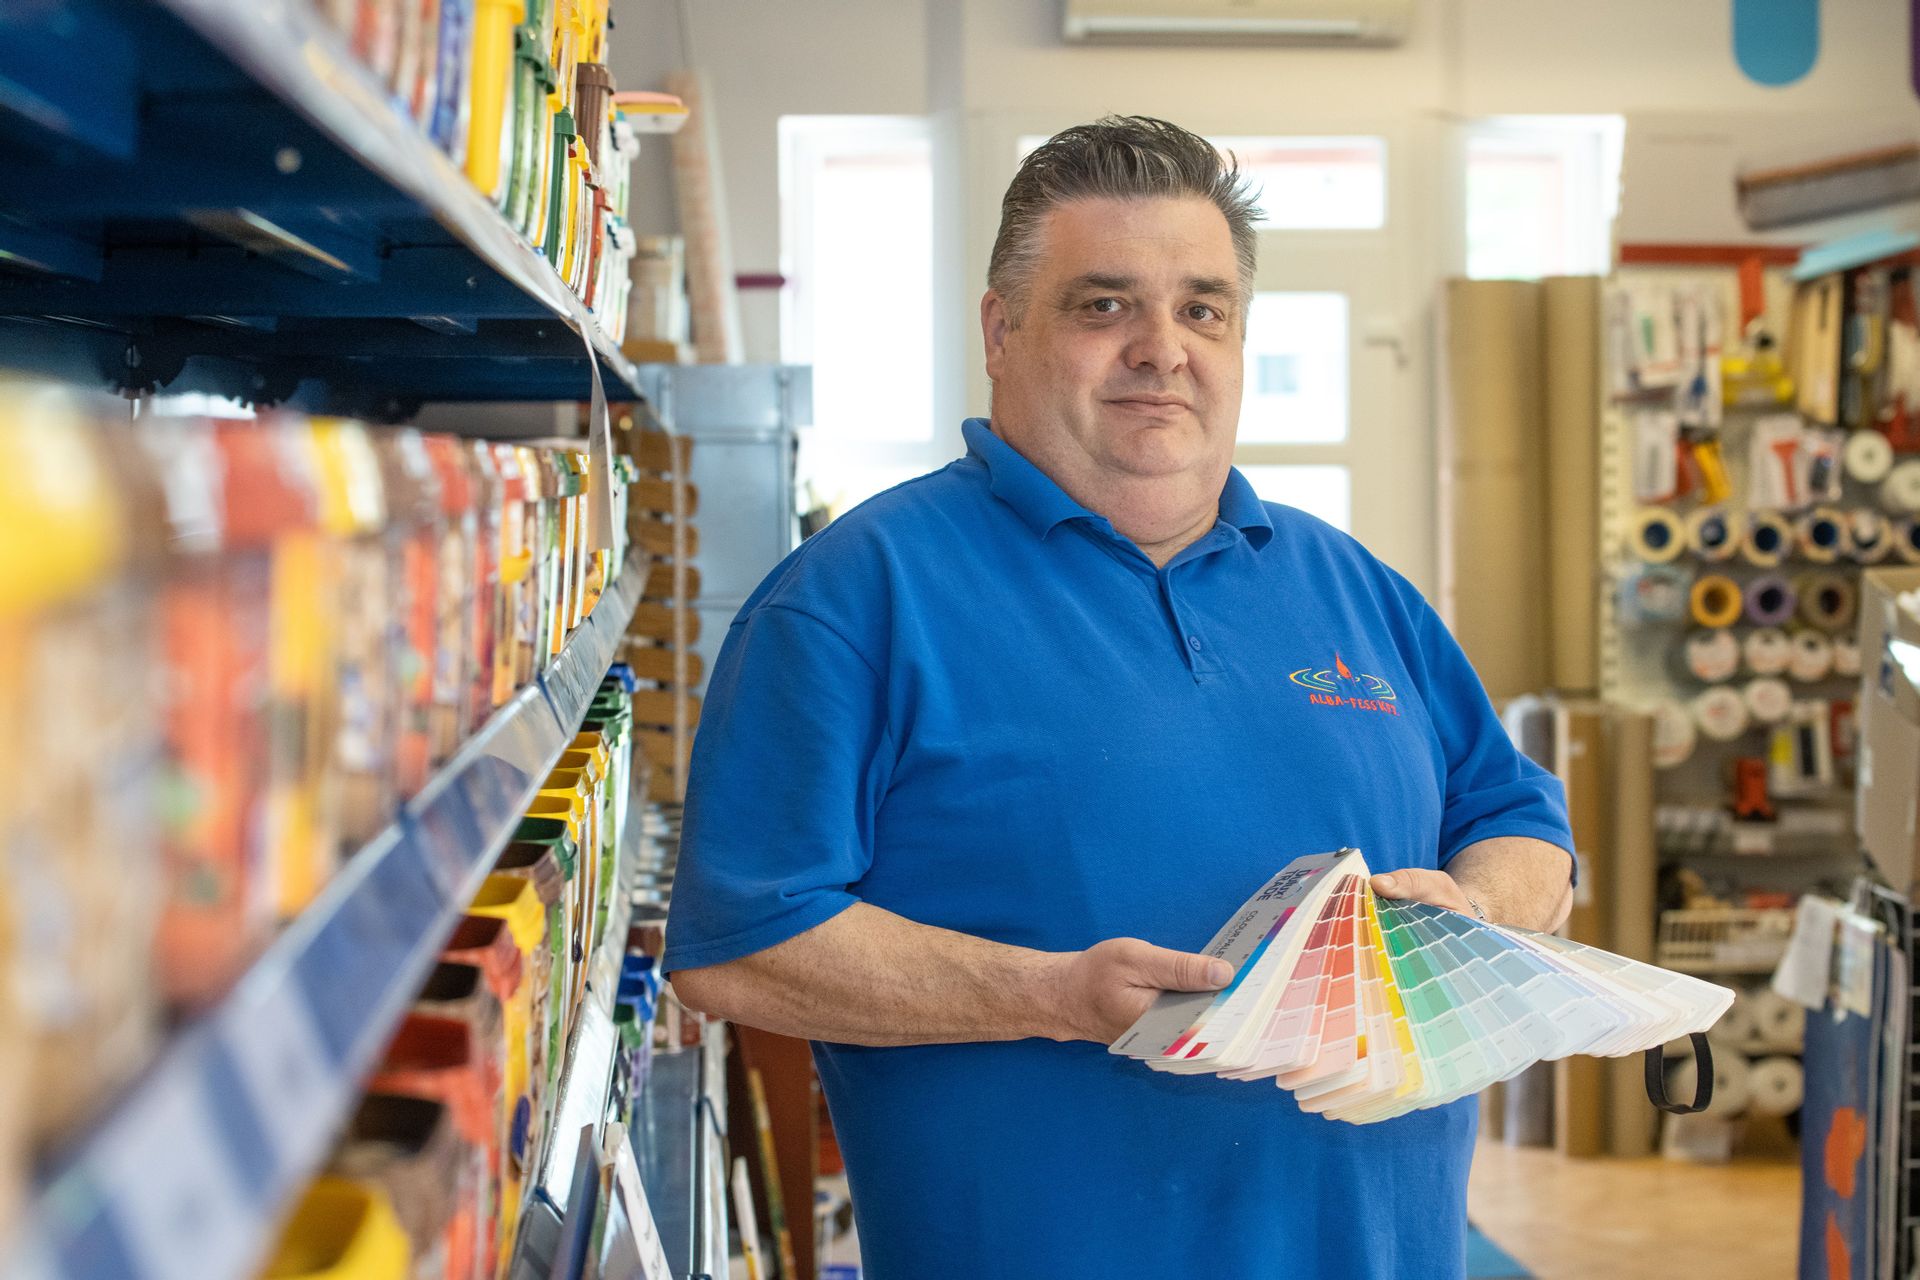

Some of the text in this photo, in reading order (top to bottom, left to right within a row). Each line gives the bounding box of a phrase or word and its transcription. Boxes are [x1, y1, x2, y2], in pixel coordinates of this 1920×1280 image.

[1310, 693, 1377, 711] ALBA-FESS
[1256, 869, 1300, 902] TRADE
[1231, 910, 1258, 938] COLOUR
